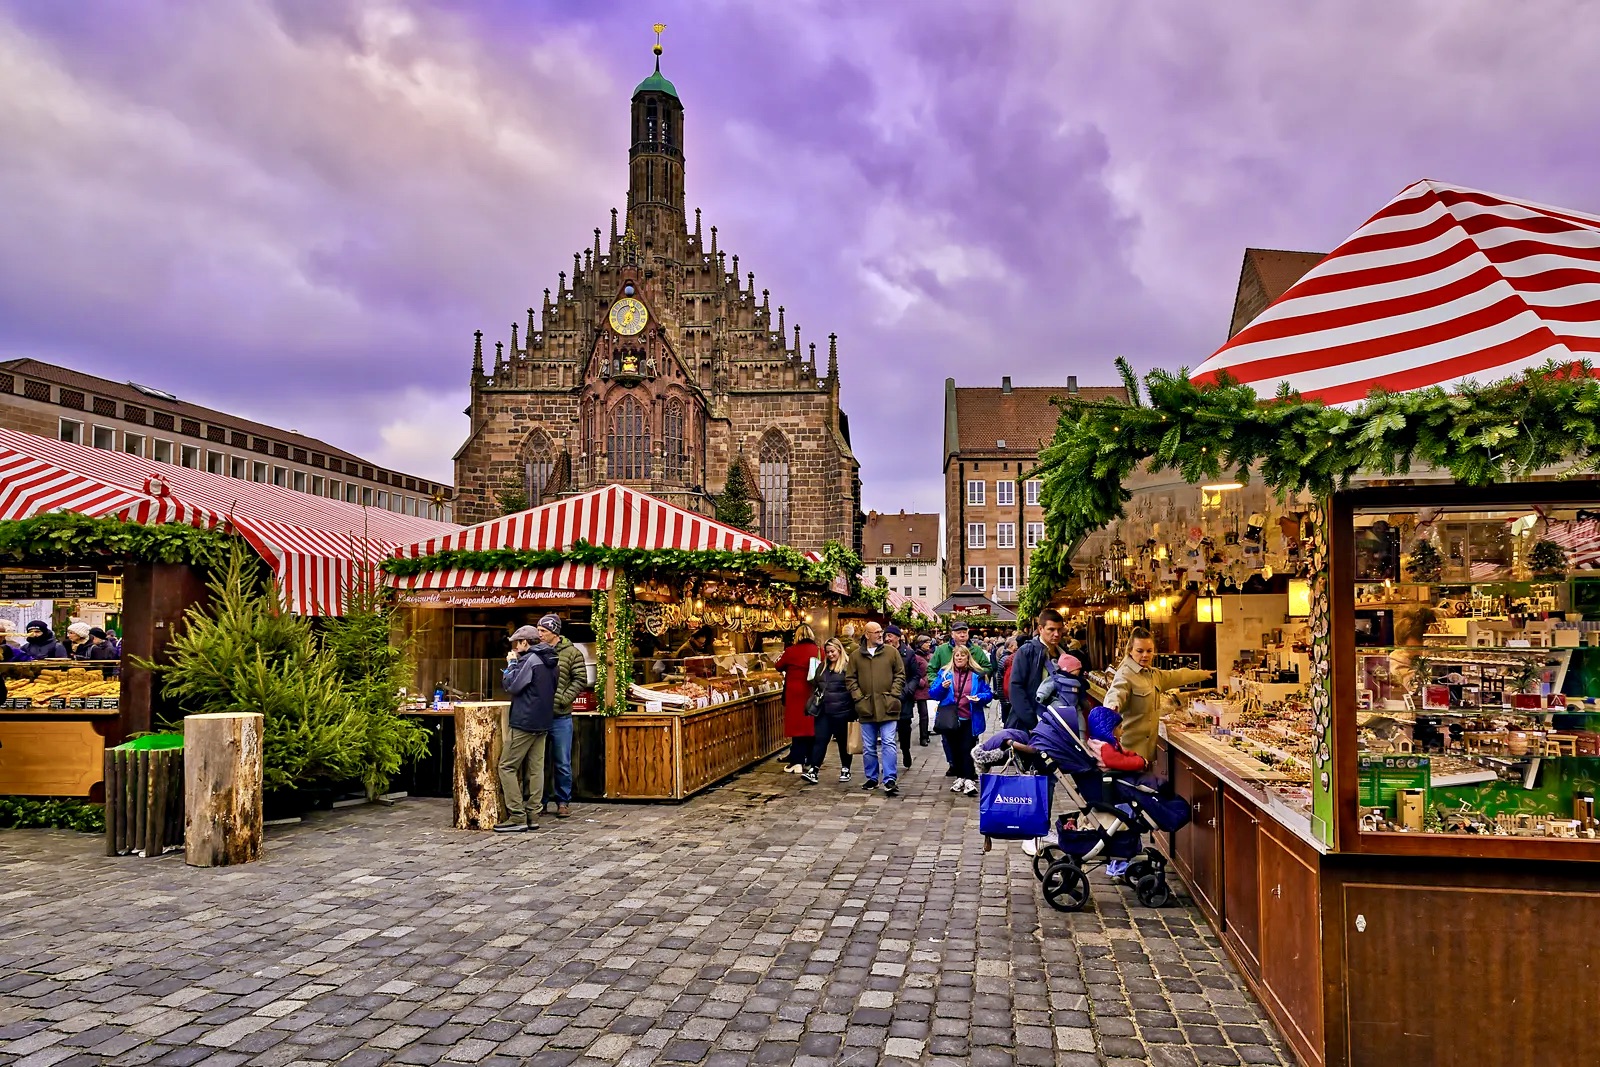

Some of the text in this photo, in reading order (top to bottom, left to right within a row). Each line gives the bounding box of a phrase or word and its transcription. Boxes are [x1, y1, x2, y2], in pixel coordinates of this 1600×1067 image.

[516, 589, 576, 600] Kokosmakronen
[446, 595, 516, 607] Marzipankartoffeln
[994, 793, 1032, 804] ANSON'S
